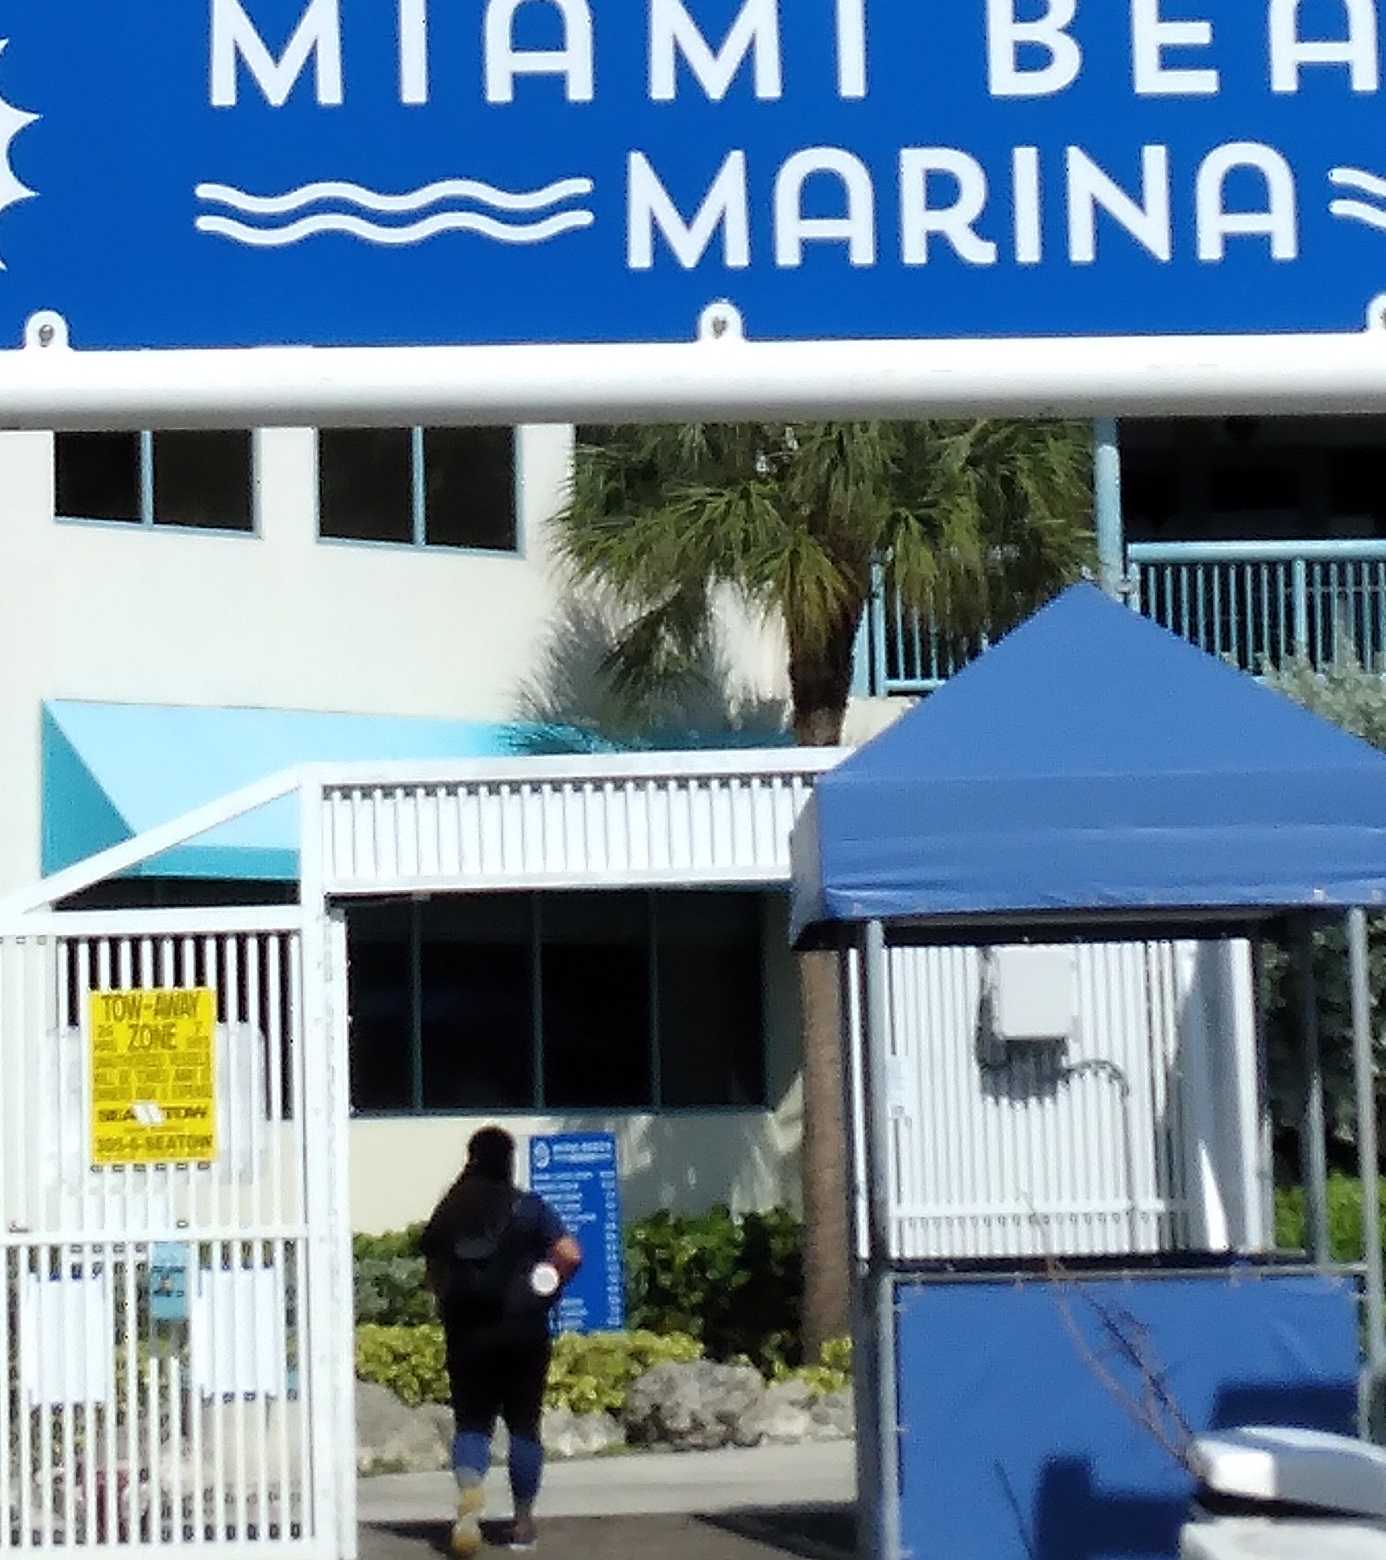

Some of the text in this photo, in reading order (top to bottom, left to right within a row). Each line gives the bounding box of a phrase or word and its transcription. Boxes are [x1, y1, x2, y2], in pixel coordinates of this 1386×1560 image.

[627, 141, 1298, 270] MARINA
[101, 992, 200, 1021] TOW-AWAY
[128, 1023, 177, 1052] ZONE
